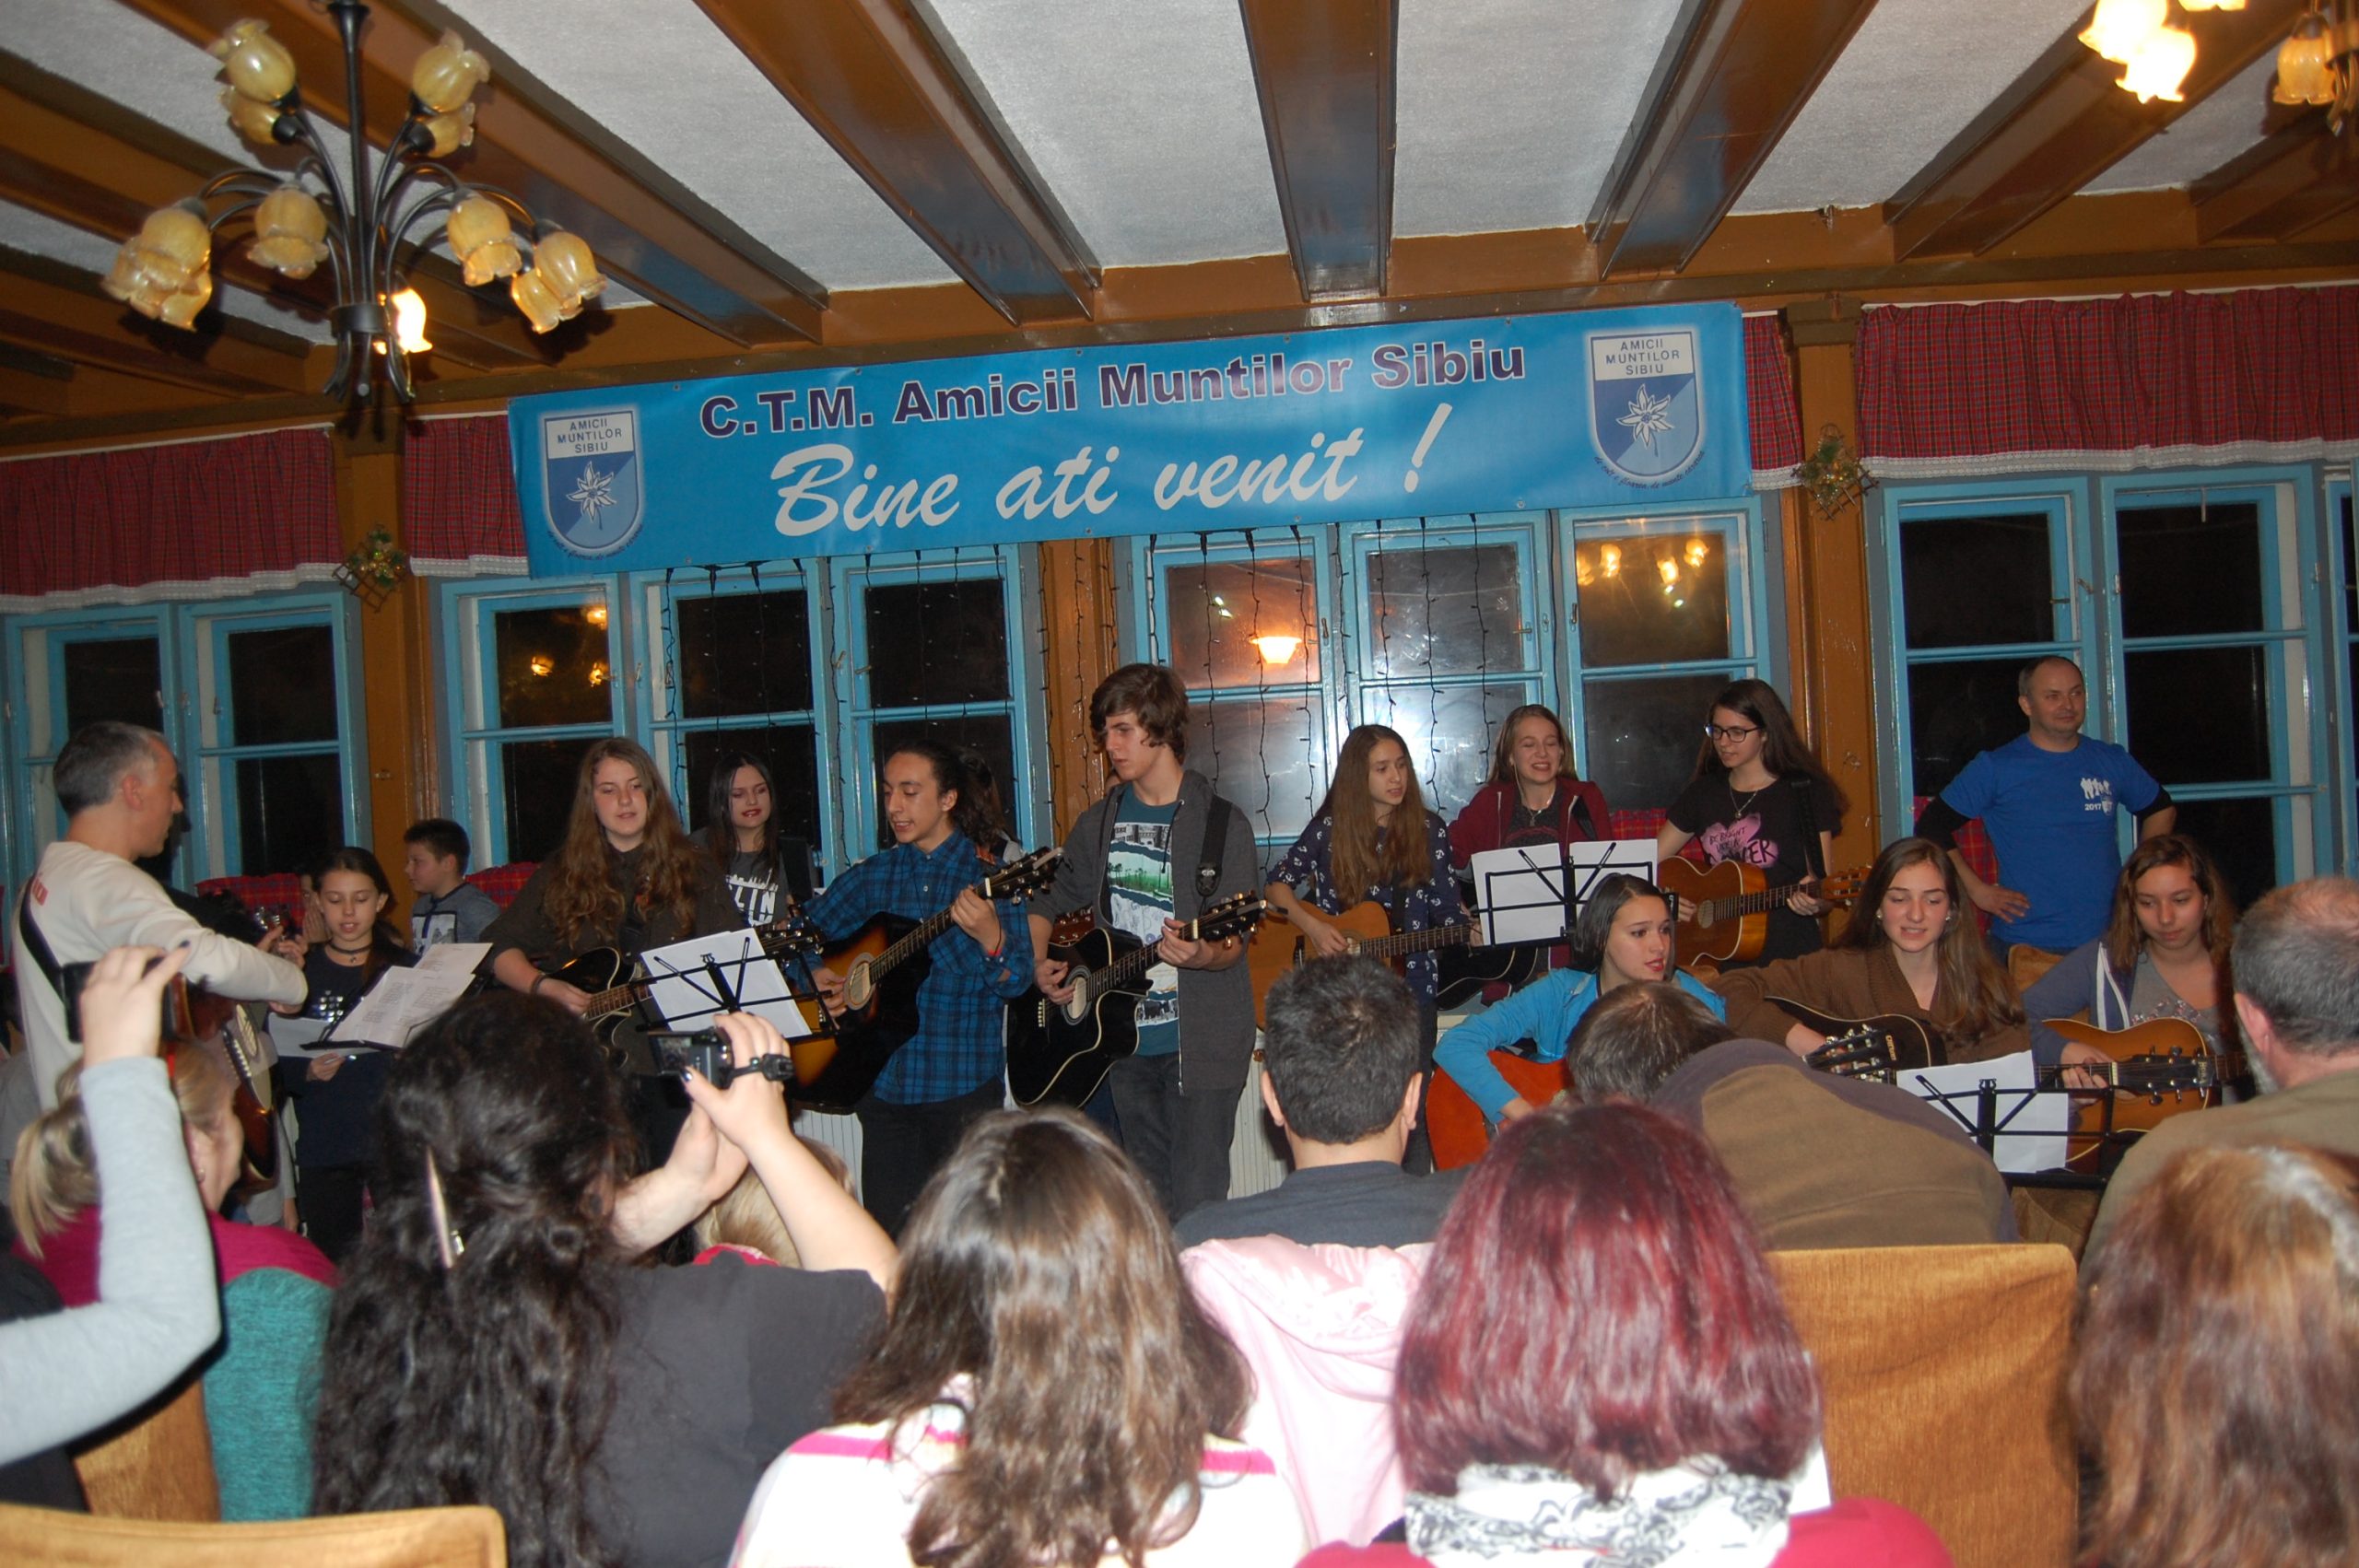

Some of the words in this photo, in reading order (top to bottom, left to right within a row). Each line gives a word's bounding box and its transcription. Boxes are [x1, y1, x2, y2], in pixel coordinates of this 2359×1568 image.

[1620, 338, 1663, 351] AMICII
[1605, 349, 1680, 365] MUNTILOR
[1625, 363, 1664, 376] SIBIU
[700, 385, 874, 438] C.T.M.
[892, 369, 1079, 424] Amicii
[1098, 353, 1353, 408] Muntilor
[1371, 339, 1526, 390] Sibiu
[569, 418, 608, 431] AMICII
[557, 427, 622, 444] MUNTILOR
[574, 441, 608, 453] SIBIU
[769, 443, 959, 536] Bine
[995, 446, 1120, 521] ati
[1154, 427, 1364, 510] venit
